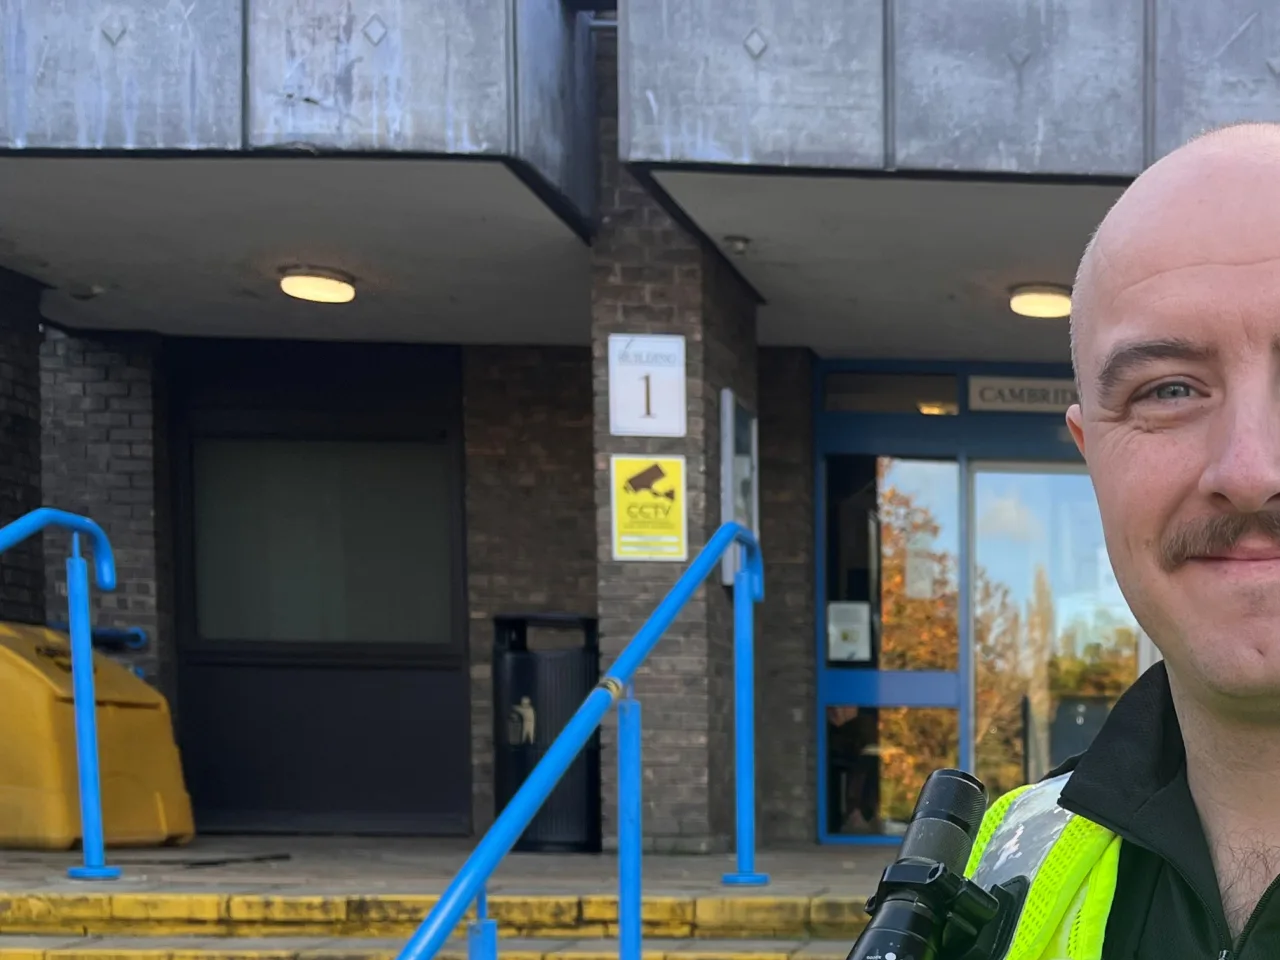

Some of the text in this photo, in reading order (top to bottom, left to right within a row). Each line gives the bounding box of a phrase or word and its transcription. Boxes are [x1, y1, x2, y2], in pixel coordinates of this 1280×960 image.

[638, 374, 656, 418] 1
[979, 386, 1078, 404] CAMBRID
[626, 502, 672, 519] CCTV
